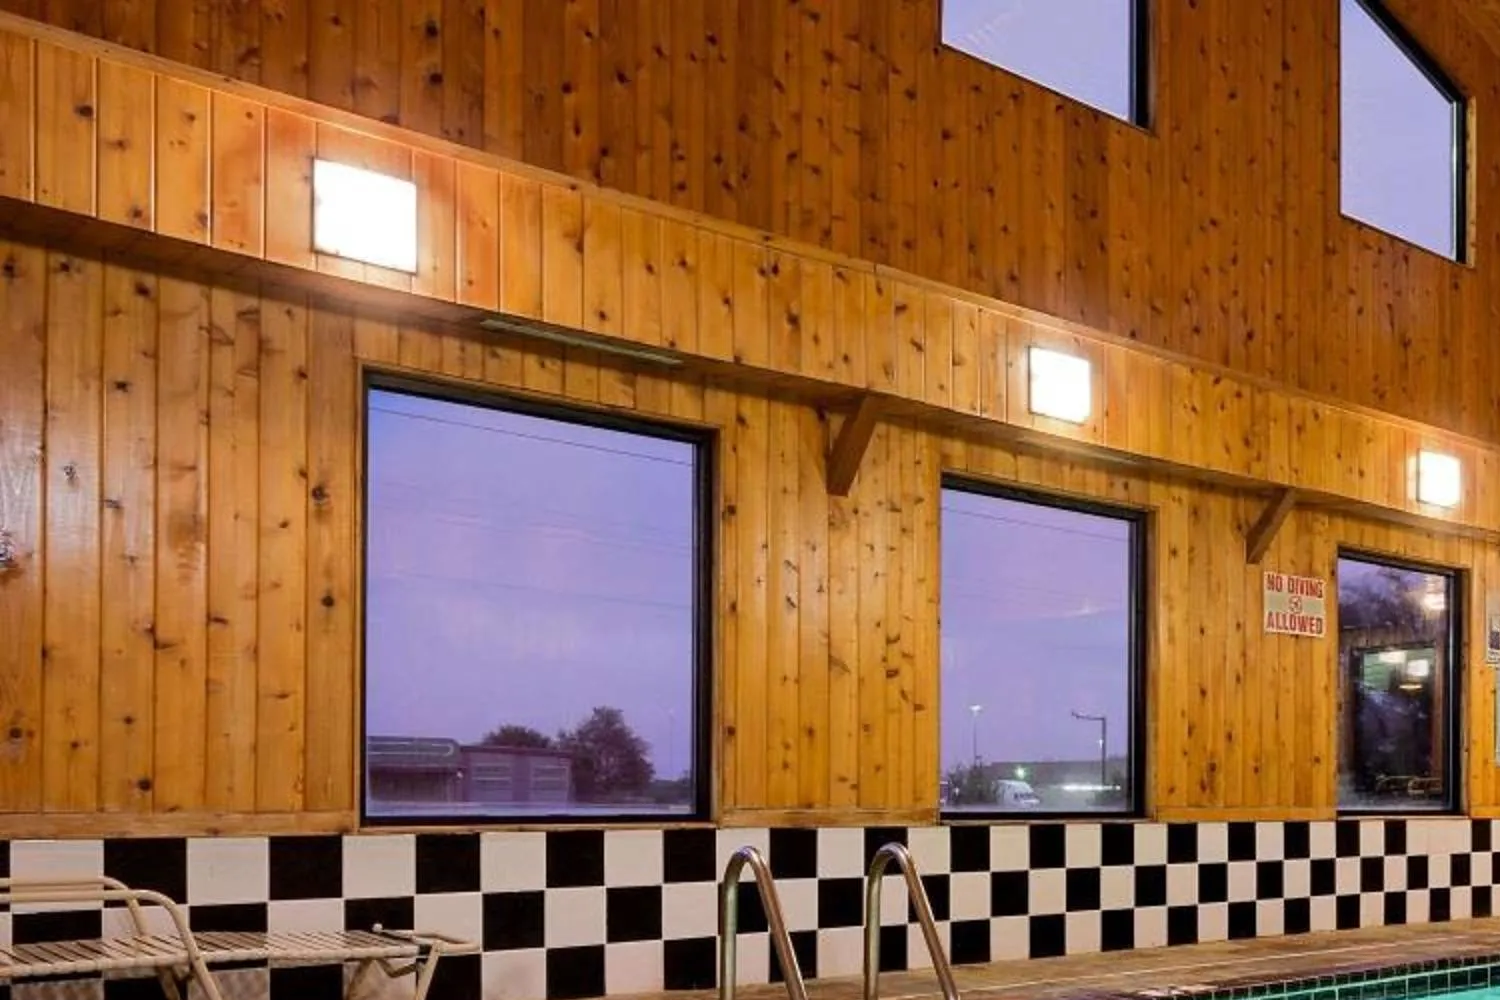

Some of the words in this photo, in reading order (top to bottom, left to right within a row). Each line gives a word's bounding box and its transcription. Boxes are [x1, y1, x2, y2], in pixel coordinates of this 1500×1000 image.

[1266, 573, 1283, 593] NO
[1287, 577, 1323, 598] DIVING
[1266, 612, 1323, 634] ALLOWED
